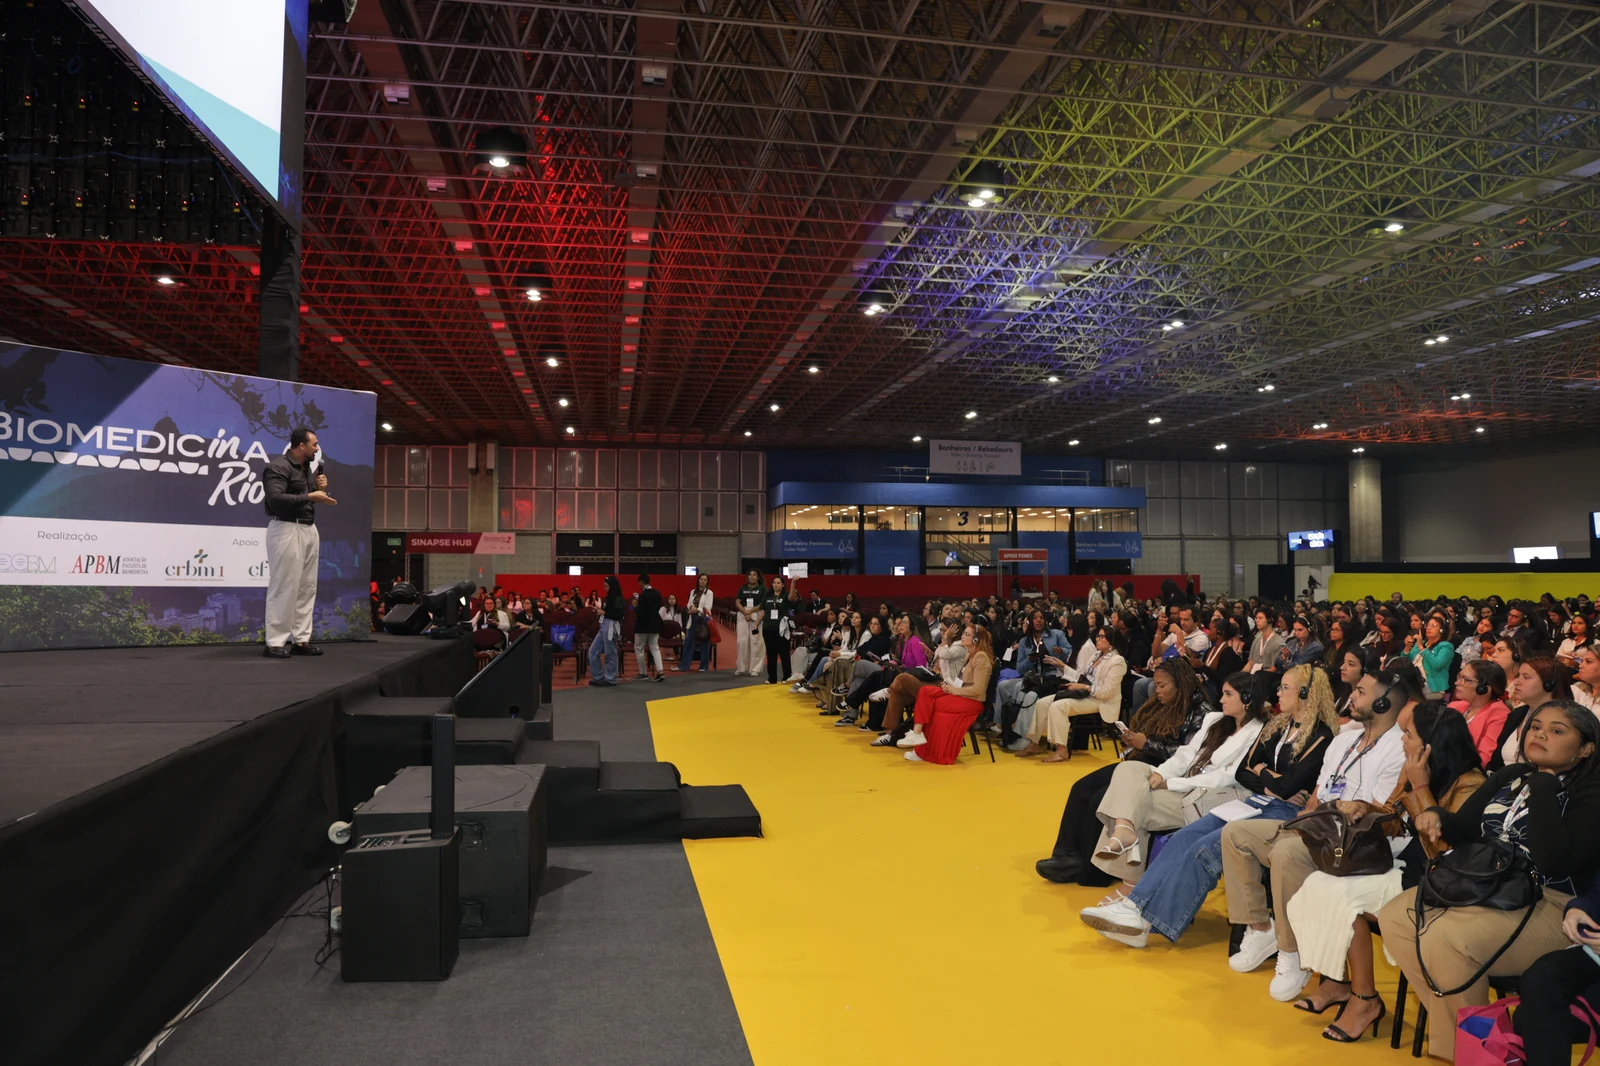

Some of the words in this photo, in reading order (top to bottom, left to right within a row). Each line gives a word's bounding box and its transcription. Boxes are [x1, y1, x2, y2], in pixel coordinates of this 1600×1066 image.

[938, 444, 971, 452] Banheiros
[978, 445, 1013, 453] Bebedouro
[207, 461, 266, 506] Rio
[958, 511, 969, 526] 3
[37, 530, 98, 542] Realização
[232, 538, 259, 547] Apoio
[411, 538, 450, 547] SINAPSE
[452, 539, 472, 547] HUB
[71, 554, 121, 574] APBM
[248, 560, 269, 577] cf
